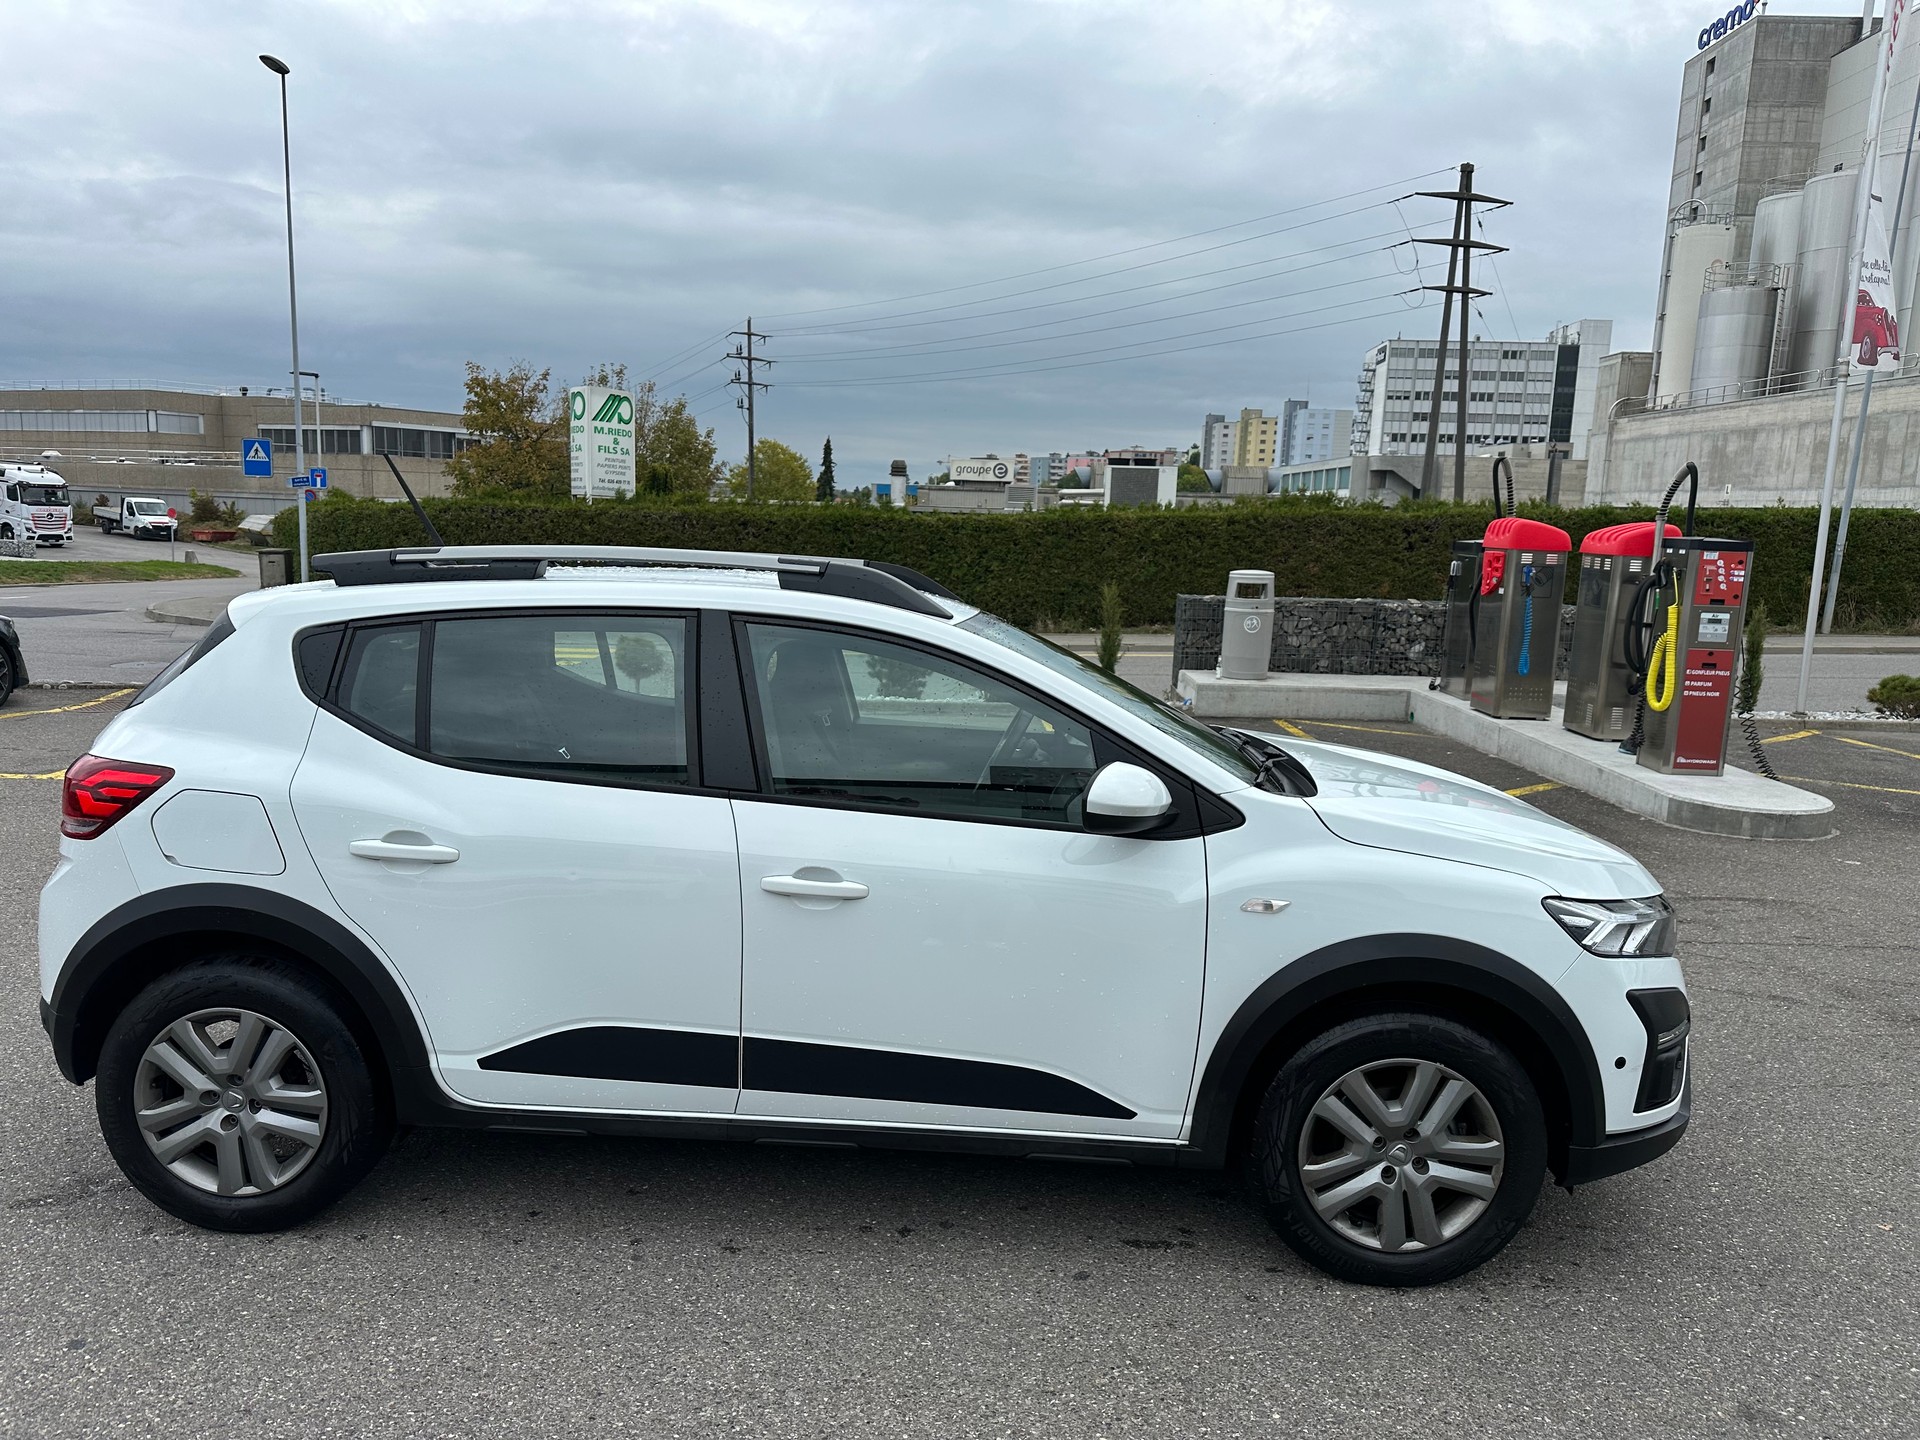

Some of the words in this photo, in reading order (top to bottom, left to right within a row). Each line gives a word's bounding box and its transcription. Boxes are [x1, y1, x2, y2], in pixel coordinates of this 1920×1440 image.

[1698, 0, 1755, 50] cremo
[594, 426, 632, 438] M.RIEDO
[613, 438, 620, 446] &
[598, 445, 618, 454] FILS
[620, 447, 630, 456] SA
[955, 465, 992, 477] groupe
